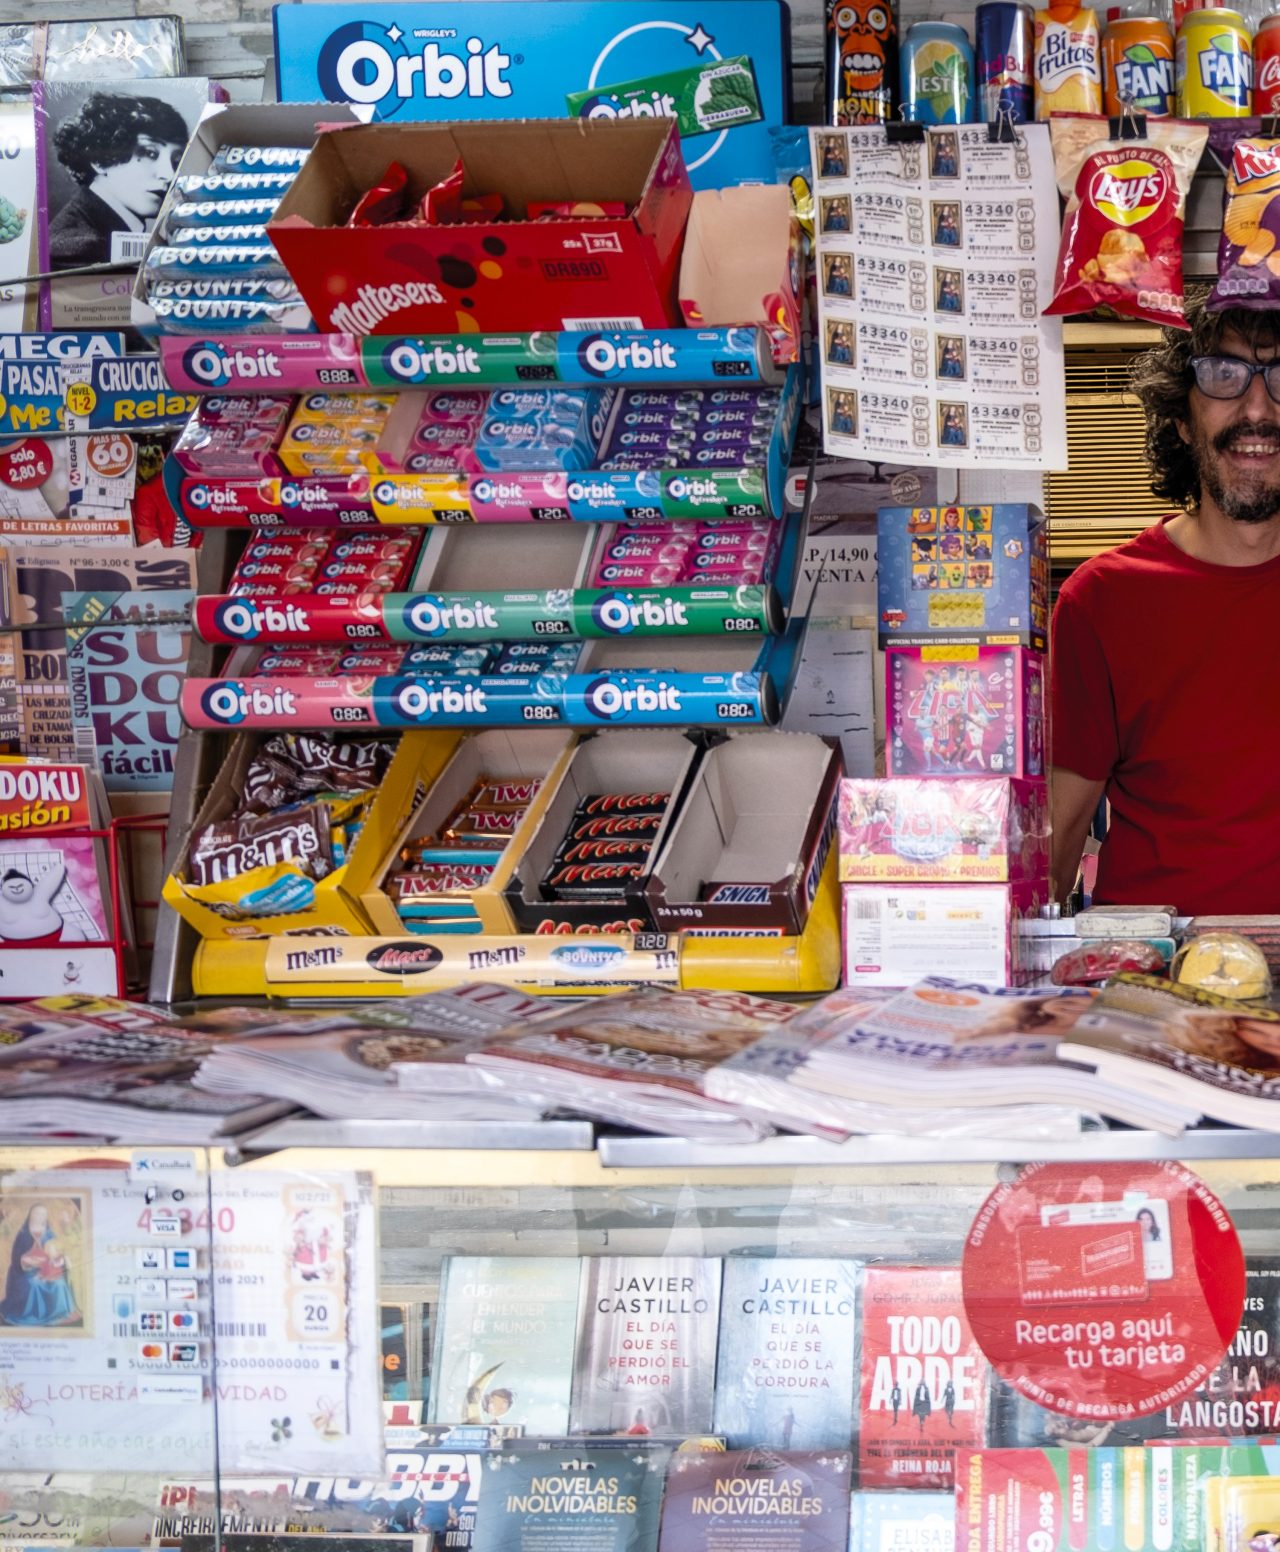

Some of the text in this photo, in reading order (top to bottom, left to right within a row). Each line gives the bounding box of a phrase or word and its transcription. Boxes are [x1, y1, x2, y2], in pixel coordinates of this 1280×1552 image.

[1047, 27, 1067, 56] Bi
[337, 37, 514, 99] Orbit
[1039, 44, 1096, 79] frutas
[915, 76, 970, 98] NESTA
[1095, 172, 1160, 212] Lay's
[965, 204, 1013, 215] 43340
[156, 280, 266, 296] BOUNTY
[967, 273, 1016, 284] 43340
[155, 300, 270, 318] BOUNTY
[330, 279, 445, 336] Maltesers
[969, 340, 1017, 352] 43340
[390, 344, 481, 375] Orbit
[72, 388, 90, 396] NIVEL
[72, 397, 91, 411] 1-2
[114, 394, 200, 422] Relax
[10, 403, 50, 430] Me
[489, 422, 535, 437] Orbit
[10, 448, 35, 463] solo
[92, 442, 128, 465] 60
[9, 465, 35, 483] 2,80
[190, 487, 238, 506] Orbit
[669, 480, 718, 498] Orbit
[3, 522, 119, 531] DE LETRAS FAVORITAS
[101, 559, 122, 567] 3,00
[805, 569, 865, 583] VENTA
[223, 602, 310, 635] Orbit
[601, 599, 688, 629] Orbit
[400, 684, 488, 716] Orbit
[101, 750, 174, 775] fácil
[586, 793, 671, 814] Mars
[554, 862, 645, 885] Mars
[398, 873, 478, 895] Twix
[286, 945, 526, 970] m&m's m&m's
[1196, 1187, 1230, 1232] MADRID
[614, 1276, 694, 1293] JAVIER
[759, 1277, 837, 1294] JAVIER
[304, 1305, 328, 1322] 20
[598, 1298, 709, 1314] CASTILLO
[742, 1300, 853, 1315] CASTILLO
[626, 1319, 676, 1333] EL DÍA
[887, 1316, 961, 1354] TODO
[1016, 1312, 1173, 1346] Recarga aquí
[622, 1339, 678, 1351] QUE SE
[608, 1354, 689, 1368] PERDIÓ EL
[1065, 1343, 1186, 1369] tu tarjeta
[625, 1375, 671, 1386] AMOR
[755, 1376, 830, 1389] CORDURA
[870, 1356, 975, 1411] ARDE
[1077, 1404, 1136, 1416] RECARGA
[1140, 1364, 1206, 1412] AUTORIZADO
[47, 1385, 138, 1400] LOTERÍA
[892, 1460, 952, 1473] REINA ROJA
[530, 1476, 619, 1495] NOVELAS
[968, 1454, 983, 1524] ENTREGA
[1102, 1462, 1113, 1527] NÚMEROS
[506, 1495, 637, 1514] INOLVIDABLES
[1073, 1474, 1085, 1523] LETRAS
[1159, 1468, 1168, 1527] COLORES
[1185, 1454, 1197, 1540] NATURALEZA
